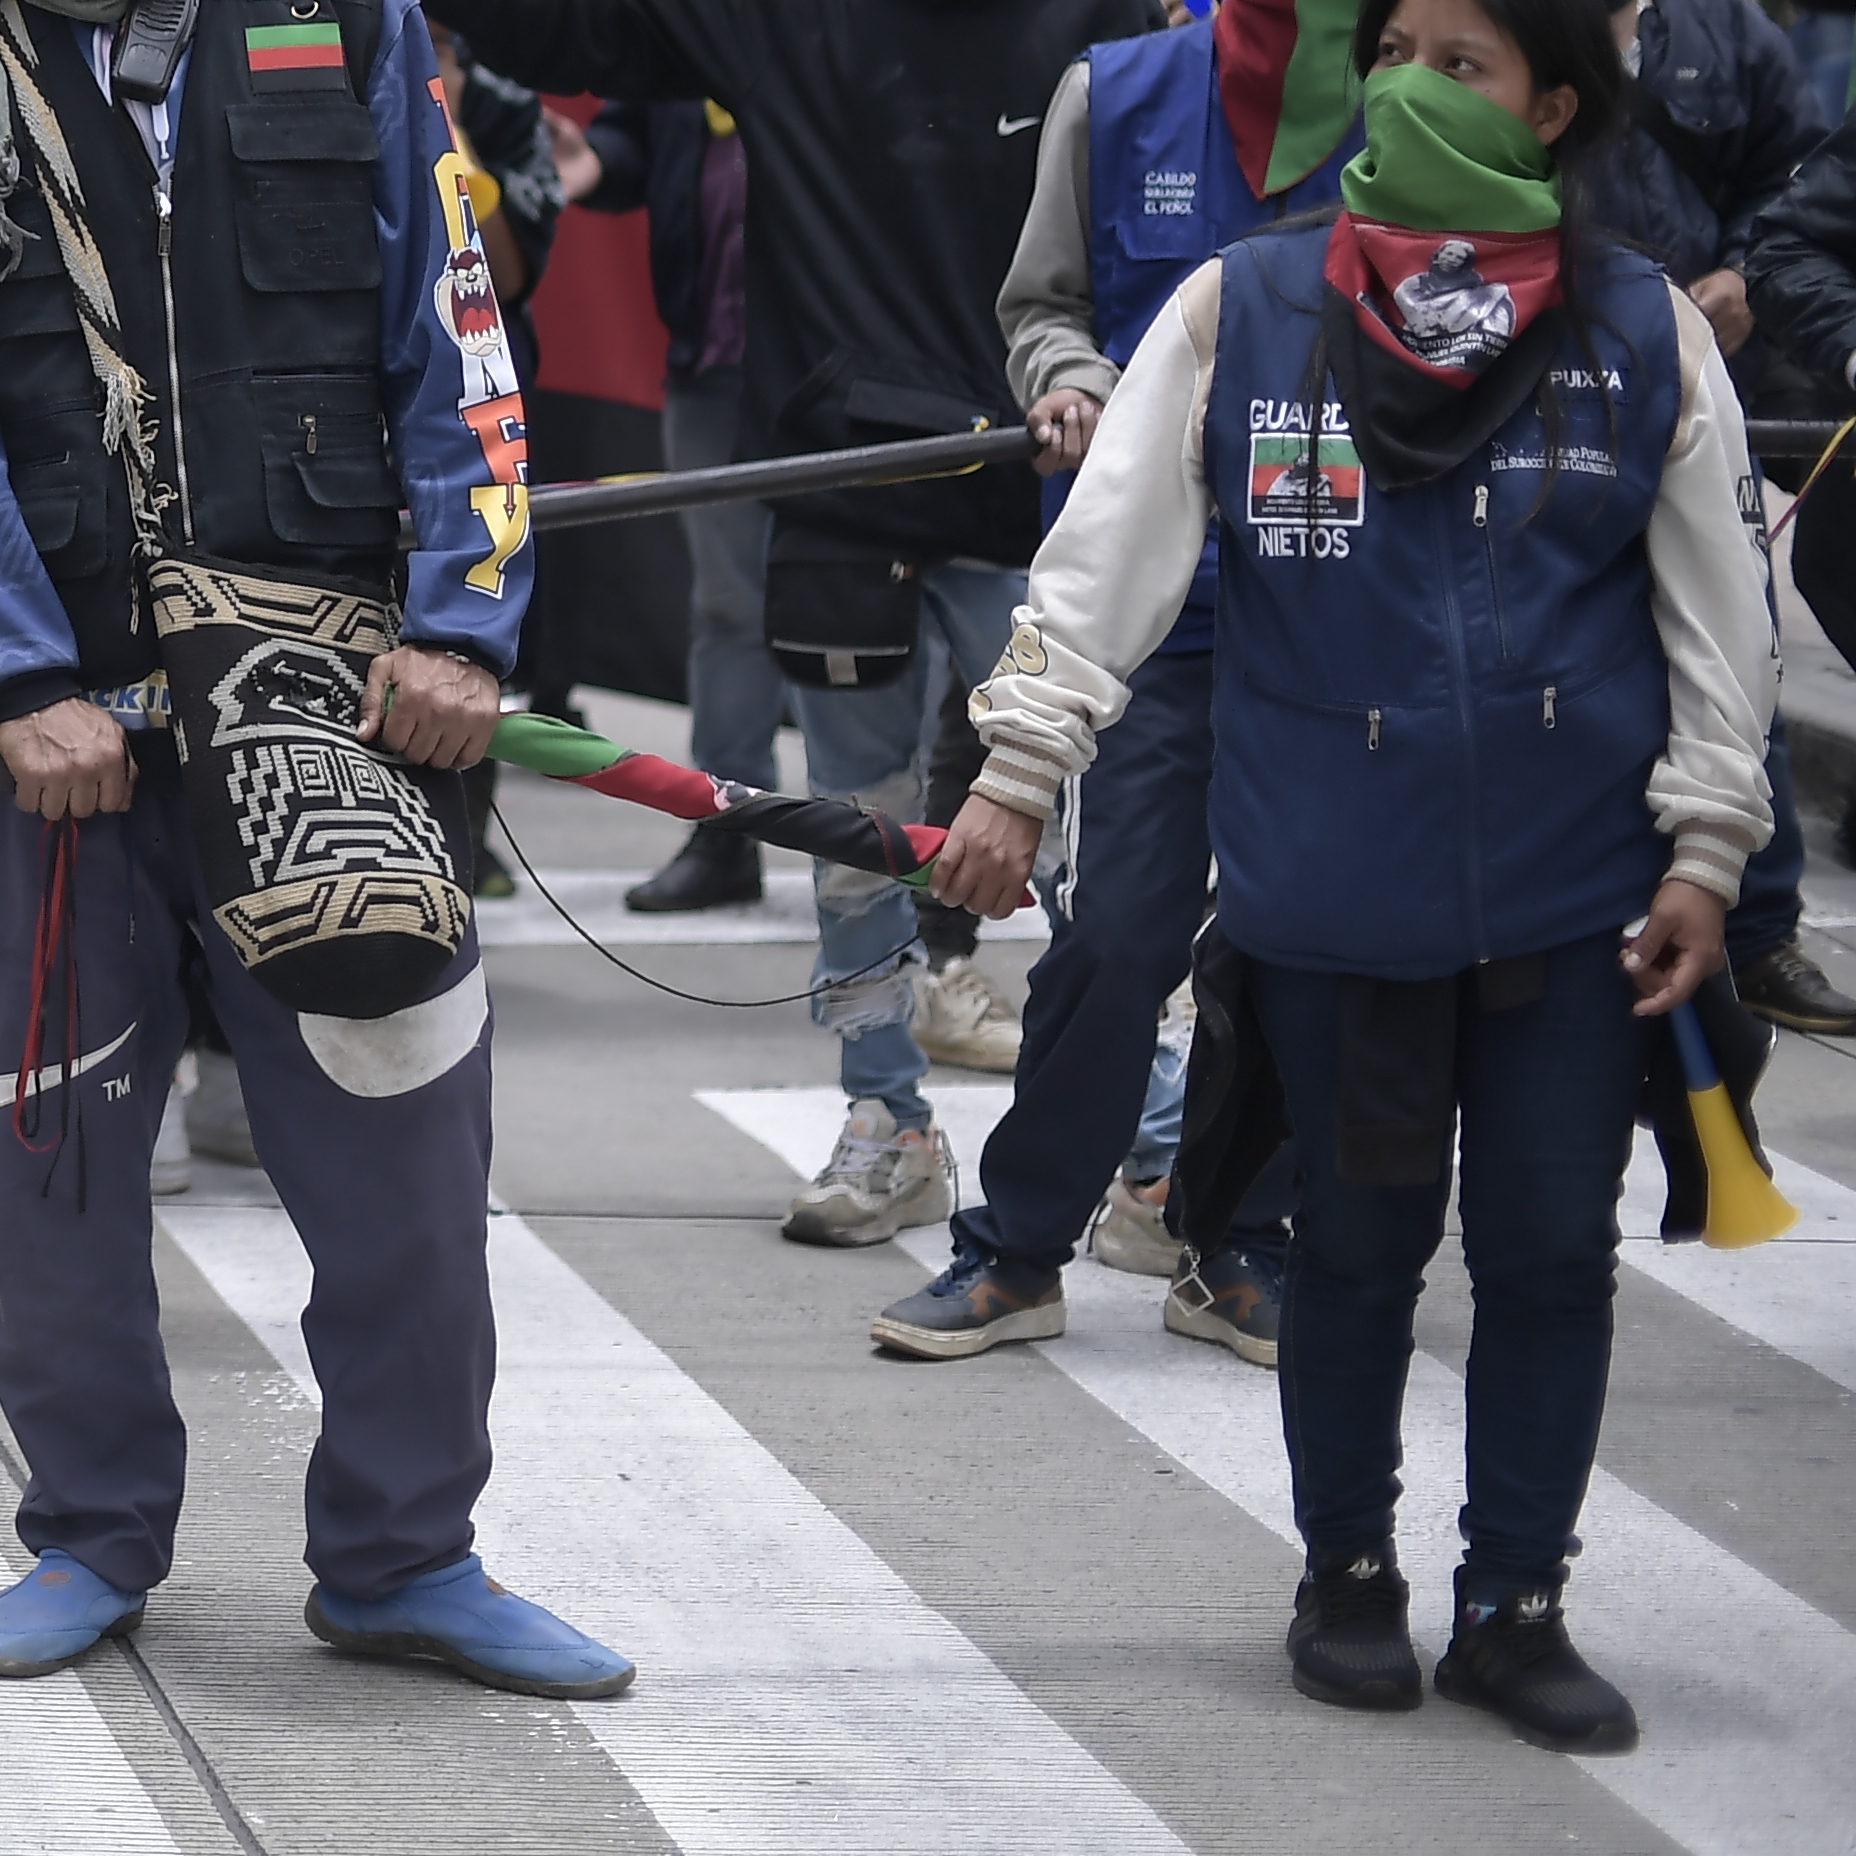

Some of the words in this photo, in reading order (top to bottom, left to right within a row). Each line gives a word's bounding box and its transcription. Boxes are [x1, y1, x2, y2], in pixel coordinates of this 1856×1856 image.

[1550, 370, 1623, 391] PUIXA
[1250, 399, 1350, 431] GUARD
[1258, 526, 1350, 559] NIETOS
[101, 1072, 132, 1102] TM
